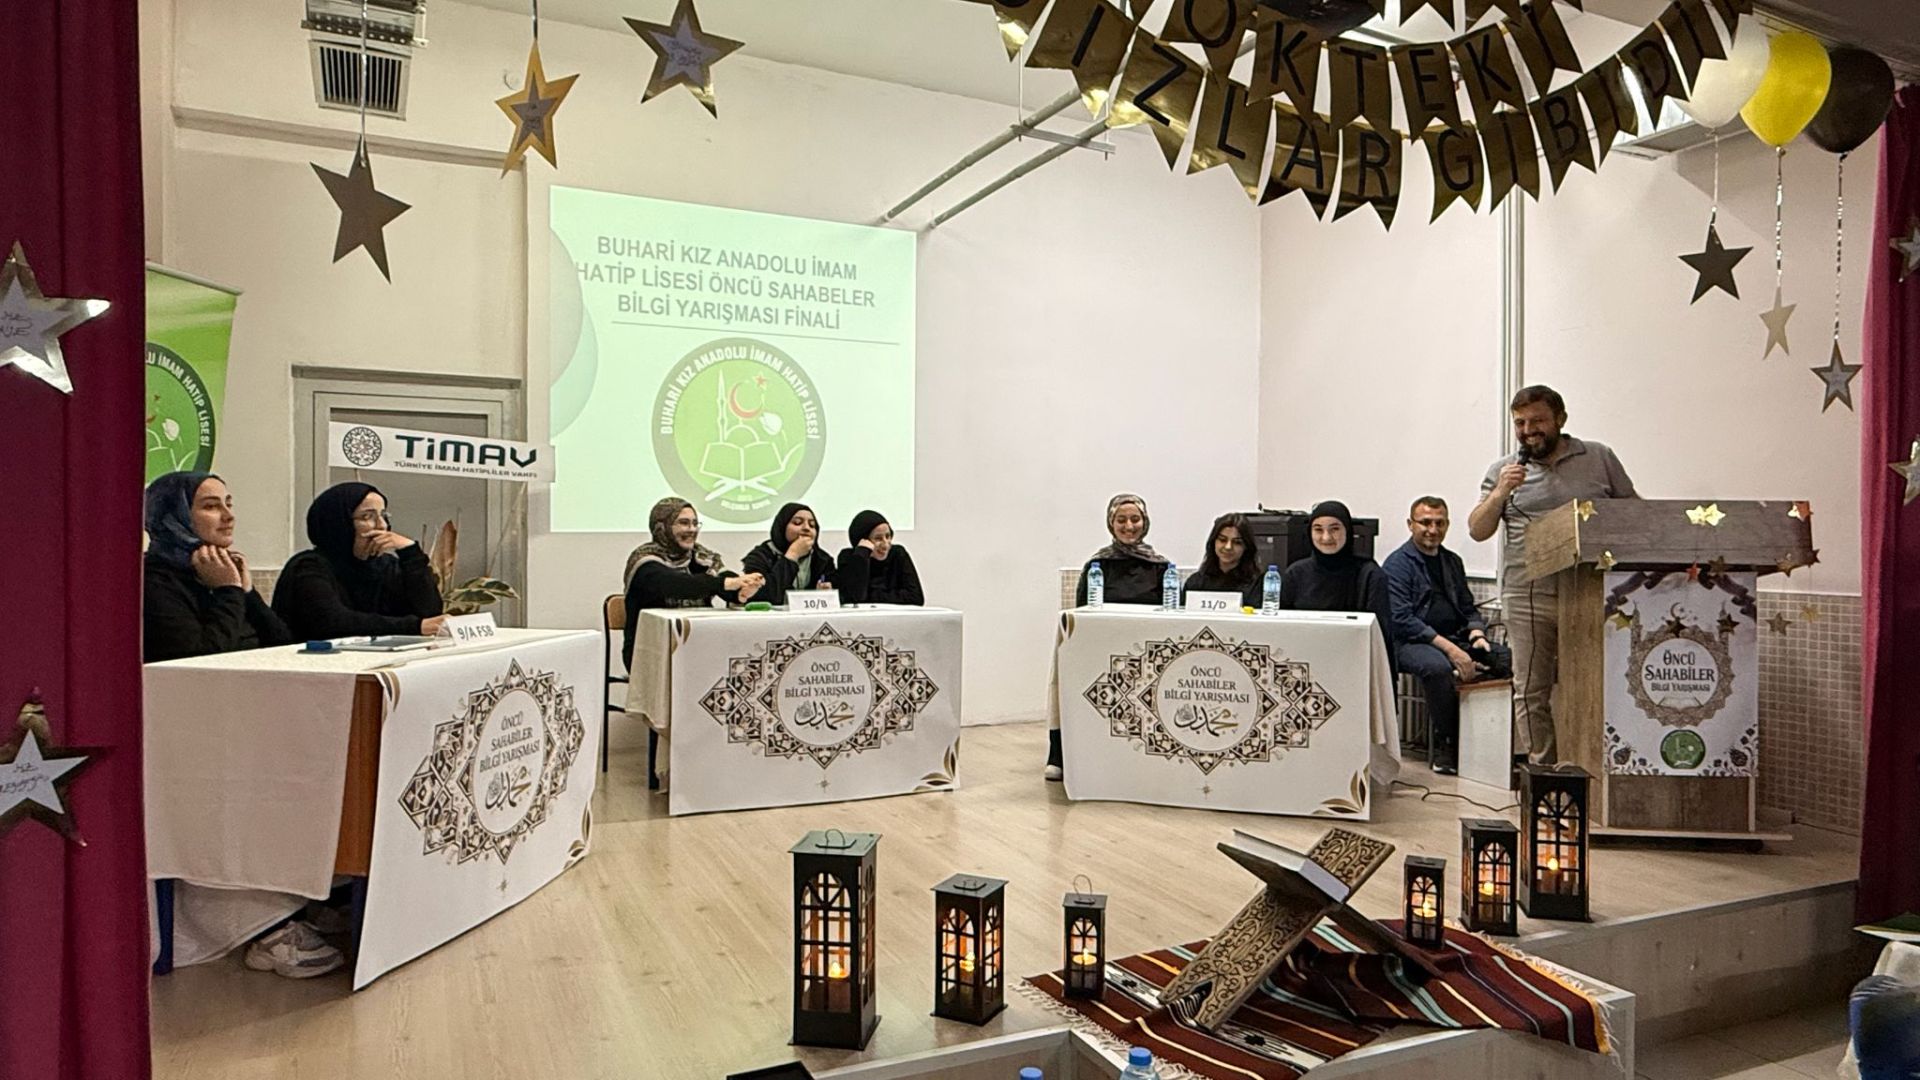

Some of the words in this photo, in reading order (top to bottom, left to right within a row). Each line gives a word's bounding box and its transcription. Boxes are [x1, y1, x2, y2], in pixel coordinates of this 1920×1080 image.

[598, 236, 675, 262] BUHARİ
[681, 244, 712, 265] KIZ
[716, 249, 807, 277] ANADOLU
[811, 255, 857, 280] İMAM
[576, 261, 636, 285] HATİP
[642, 265, 704, 292] LİSESİ
[709, 272, 763, 297] ÖNCÜ
[768, 281, 876, 308] SAHABELER
[617, 291, 670, 316] BİLGİ
[676, 300, 779, 325] YARIŞMASI
[784, 305, 841, 330] FİNALİ
[660, 383, 682, 434] BUHARİ
[676, 365, 697, 387] KIZ
[694, 346, 747, 371] ANADOLU
[750, 345, 783, 371] İMAM
[781, 365, 810, 399] HATİP
[802, 400, 821, 439] LİSESİ
[158, 352, 185, 379] İMAM
[182, 375, 206, 407] HATİP
[198, 410, 211, 447] LİSESİ
[394, 459, 433, 470] TÜRKİYE
[434, 464, 461, 473] İMAM
[804, 599, 828, 610] 10/B
[1201, 600, 1227, 611] 11/D
[457, 625, 477, 641] 9/A
[810, 660, 840, 673] ÖNCÜ
[1190, 665, 1221, 678] ÖNCÜ
[798, 673, 854, 686] SAHABİLER
[1177, 678, 1237, 691] SAHABİLER
[785, 686, 811, 698] BİLGİ
[813, 685, 865, 698] YARIŞMASI
[1164, 688, 1192, 700] BİLGİ
[1193, 691, 1250, 705] YARIŞMASI
